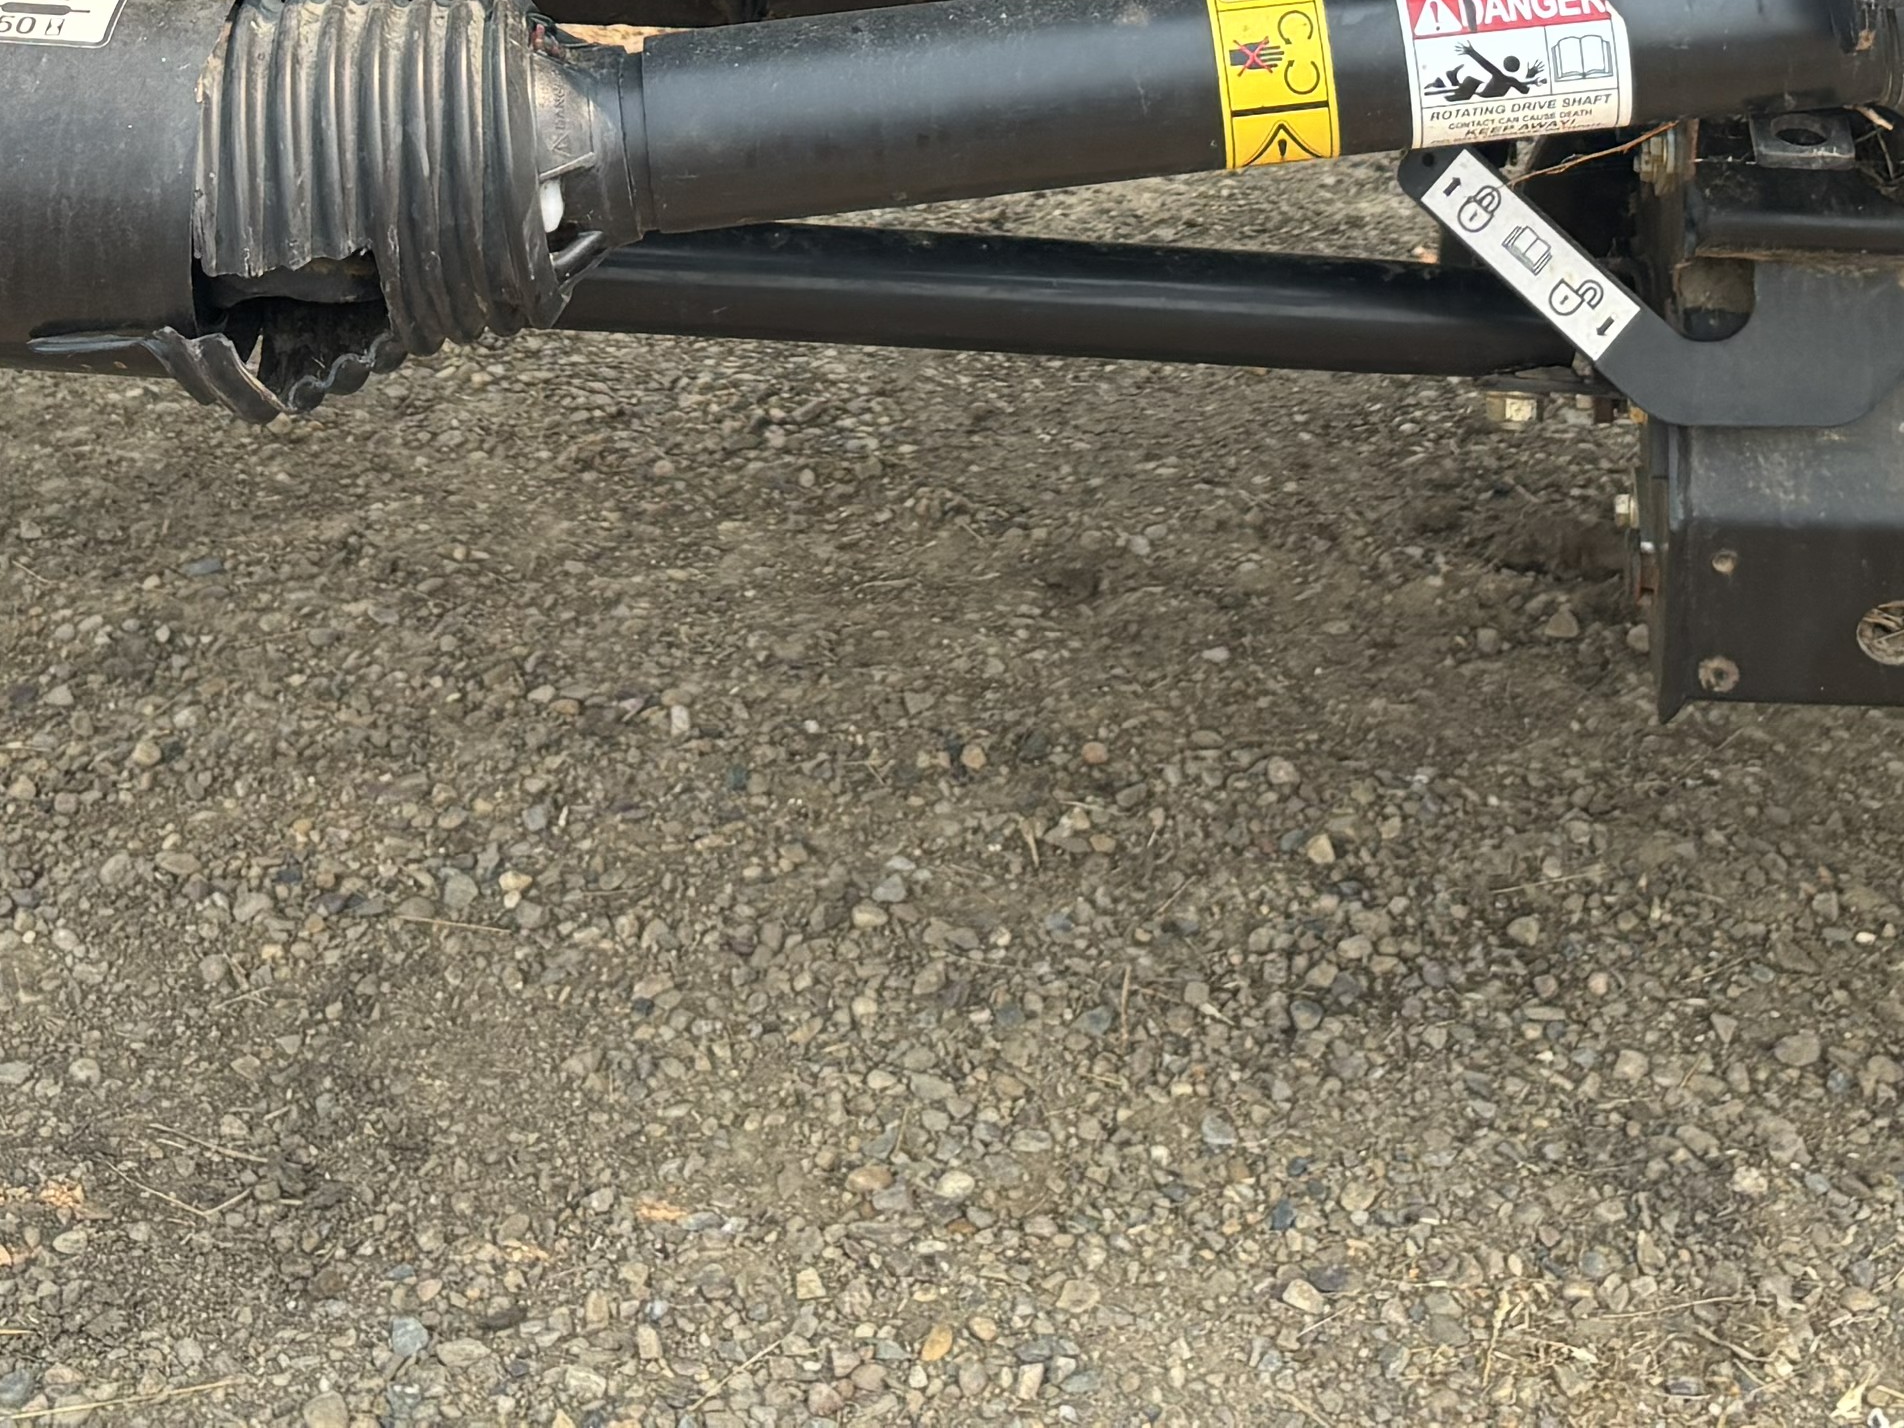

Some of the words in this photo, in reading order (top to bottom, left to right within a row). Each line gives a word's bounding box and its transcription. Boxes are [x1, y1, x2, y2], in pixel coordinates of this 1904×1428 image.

[1430, 104, 1506, 122] ROTATING
[1510, 98, 1557, 114] DRIVE
[1561, 93, 1613, 108] SHAFT
[1448, 118, 1496, 131] CONTACT
[1498, 116, 1520, 125] CAN
[1522, 112, 1557, 122] CAUSE
[1559, 109, 1593, 120] DEATH
[1464, 122, 1515, 139] KEEP
